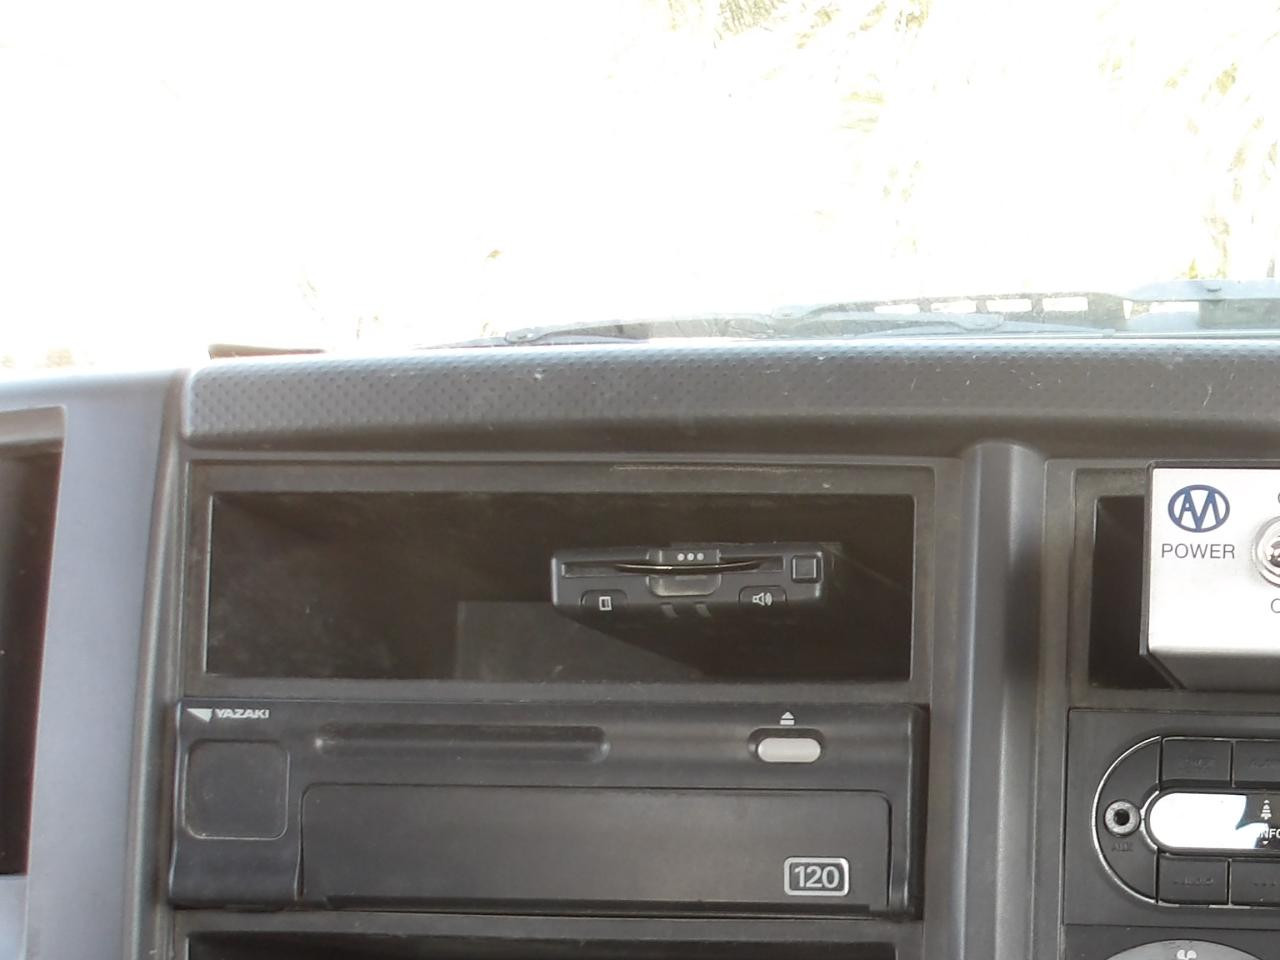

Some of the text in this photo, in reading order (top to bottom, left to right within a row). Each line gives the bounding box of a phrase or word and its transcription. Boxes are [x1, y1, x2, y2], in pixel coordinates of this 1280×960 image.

[1161, 543, 1236, 560] POWER
[214, 708, 270, 719] YAZAKI
[794, 865, 840, 889] 120
